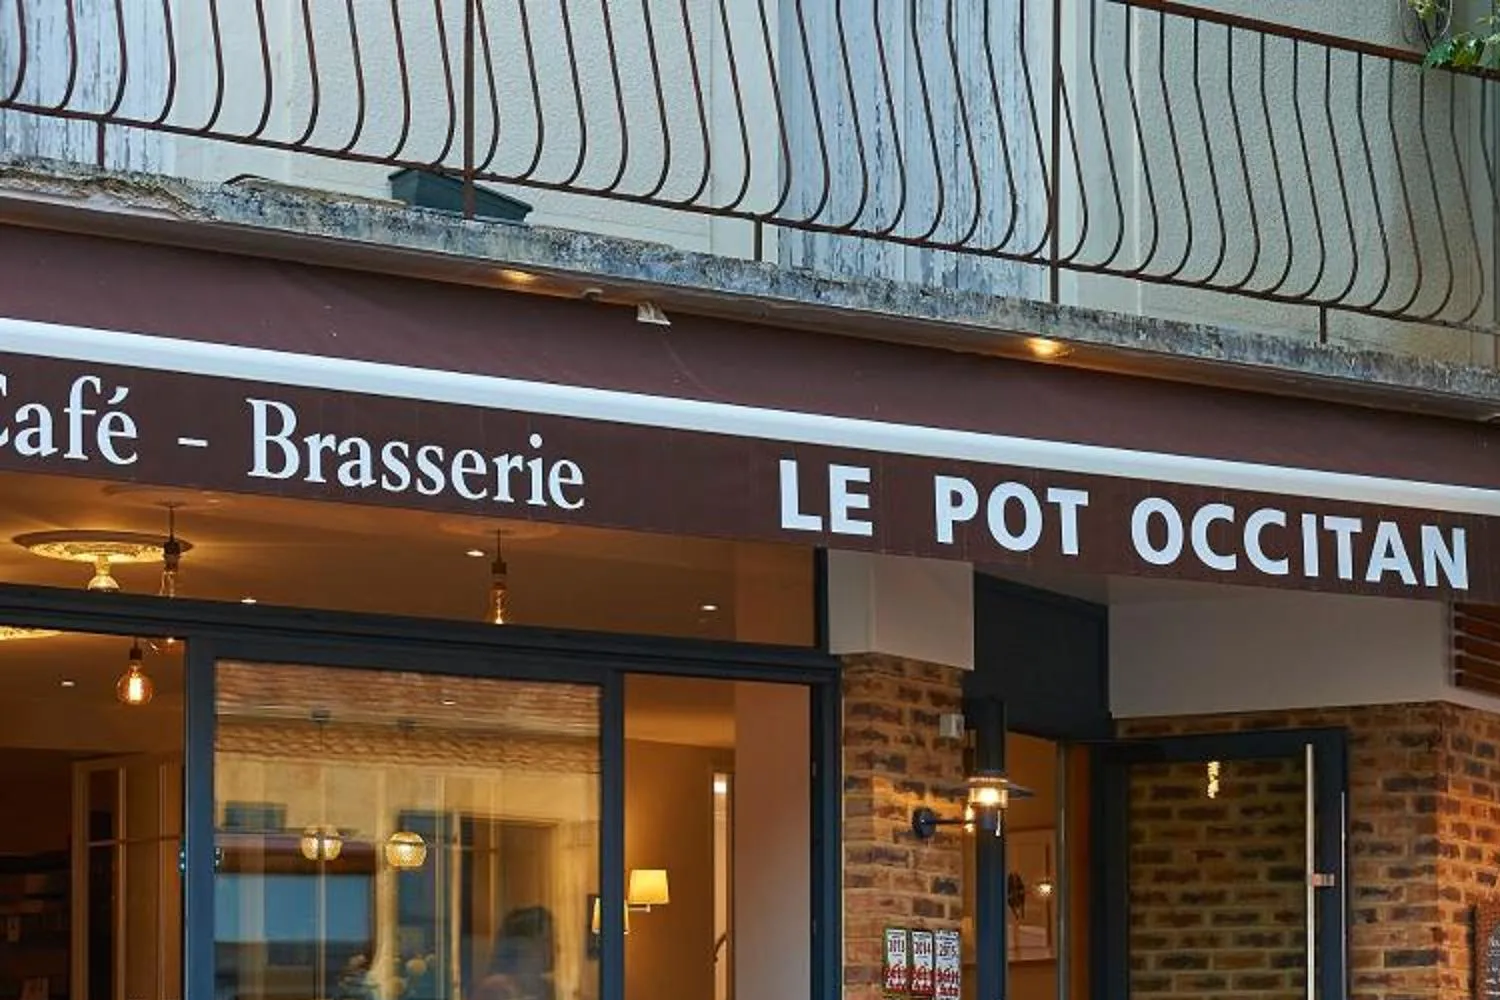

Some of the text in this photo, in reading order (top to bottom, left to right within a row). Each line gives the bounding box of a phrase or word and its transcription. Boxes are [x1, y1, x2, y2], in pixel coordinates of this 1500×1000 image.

[0, 373, 139, 465] afé
[246, 398, 585, 511] Brasserie
[779, 459, 1469, 590] LE POT OCCITAN
